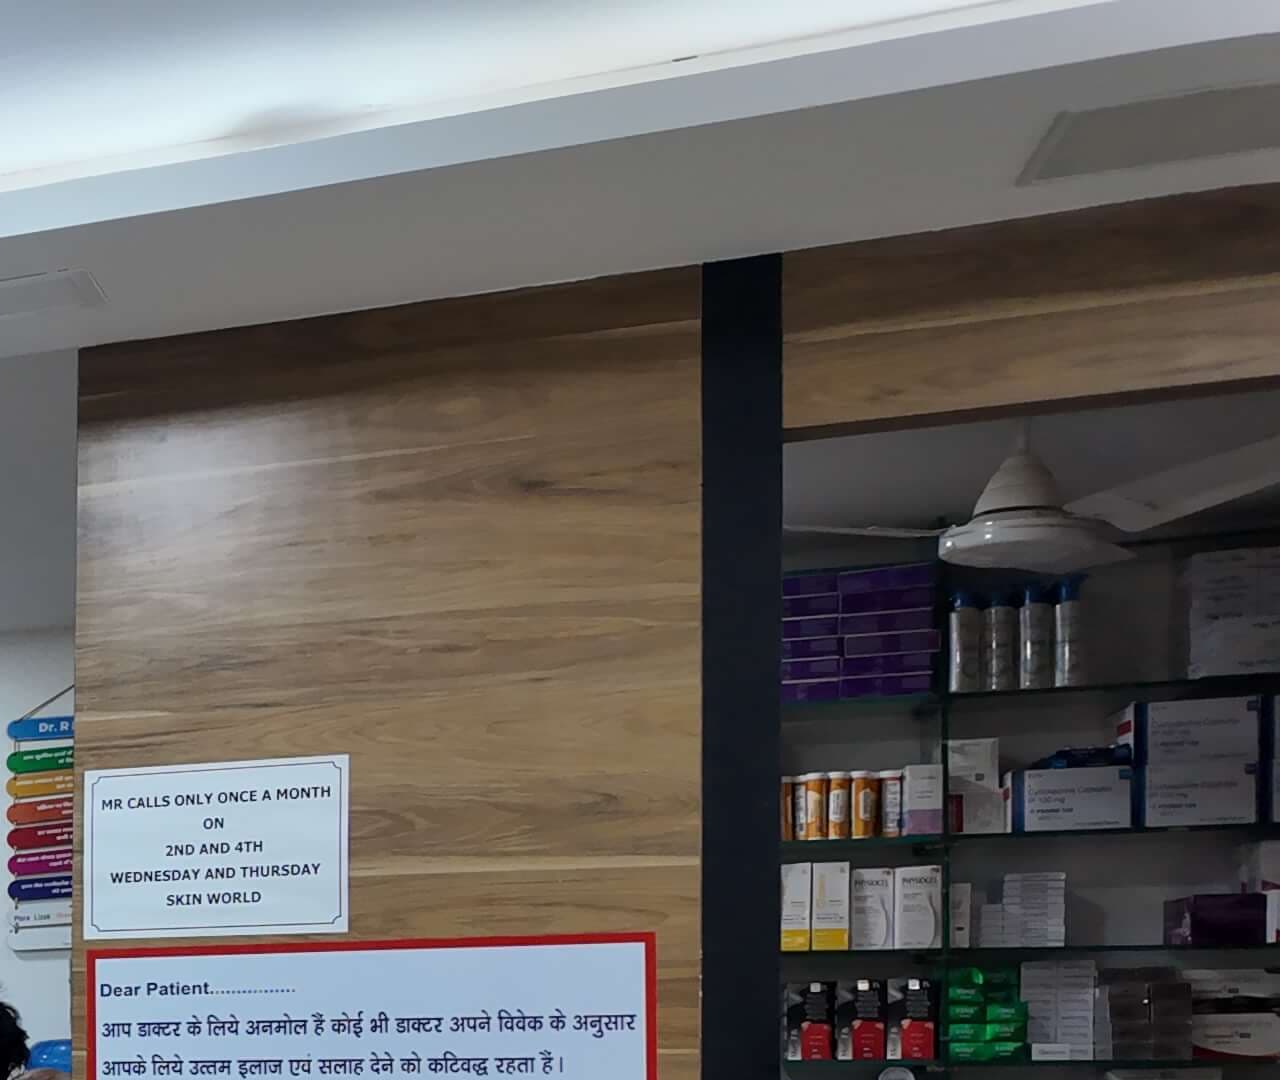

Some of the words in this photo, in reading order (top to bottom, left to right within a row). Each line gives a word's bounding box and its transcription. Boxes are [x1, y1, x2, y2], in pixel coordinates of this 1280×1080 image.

[39, 720, 58, 733] Dr.
[101, 799, 123, 811] MR
[127, 795, 171, 809] CALLS
[174, 792, 213, 807] ONLY
[217, 790, 257, 804] ONCE
[262, 789, 272, 801] A
[276, 786, 331, 801] MONTH
[203, 818, 225, 830] ON
[165, 844, 195, 857] 2ND
[199, 842, 230, 855] AND
[234, 841, 263, 853] 4TH
[110, 869, 200, 884] WEDNESDAY
[204, 867, 236, 880] AND
[240, 863, 321, 878] THURSDAY
[166, 894, 202, 907] SKIN
[207, 891, 262, 905] WORLD
[100, 983, 141, 997] Dear
[102, 1021, 131, 1038] आप
[137, 1020, 181, 1038] डाक्टर
[187, 1015, 202, 1037] के
[206, 1013, 240, 1036] लिये
[245, 1013, 308, 1036] अनमोल
[312, 1011, 327, 1036] हैं
[331, 1011, 364, 1038] कोई
[369, 1011, 390, 1034] भी
[395, 1016, 444, 1034] डाक्टर
[449, 1009, 492, 1033] अपने
[497, 1009, 544, 1033] विवेक
[549, 1008, 566, 1032] के
[572, 1013, 637, 1038] अनुसार
[102, 1054, 146, 1076] आपके
[151, 1053, 184, 1076] लिये
[189, 1059, 232, 1075] उत्तम
[236, 1058, 283, 1079] इलाज
[288, 1052, 312, 1076] एवं
[317, 1058, 365, 1075] सलाह
[370, 1051, 394, 1075] देने
[400, 1051, 422, 1074] को
[494, 1056, 536, 1075] रहता
